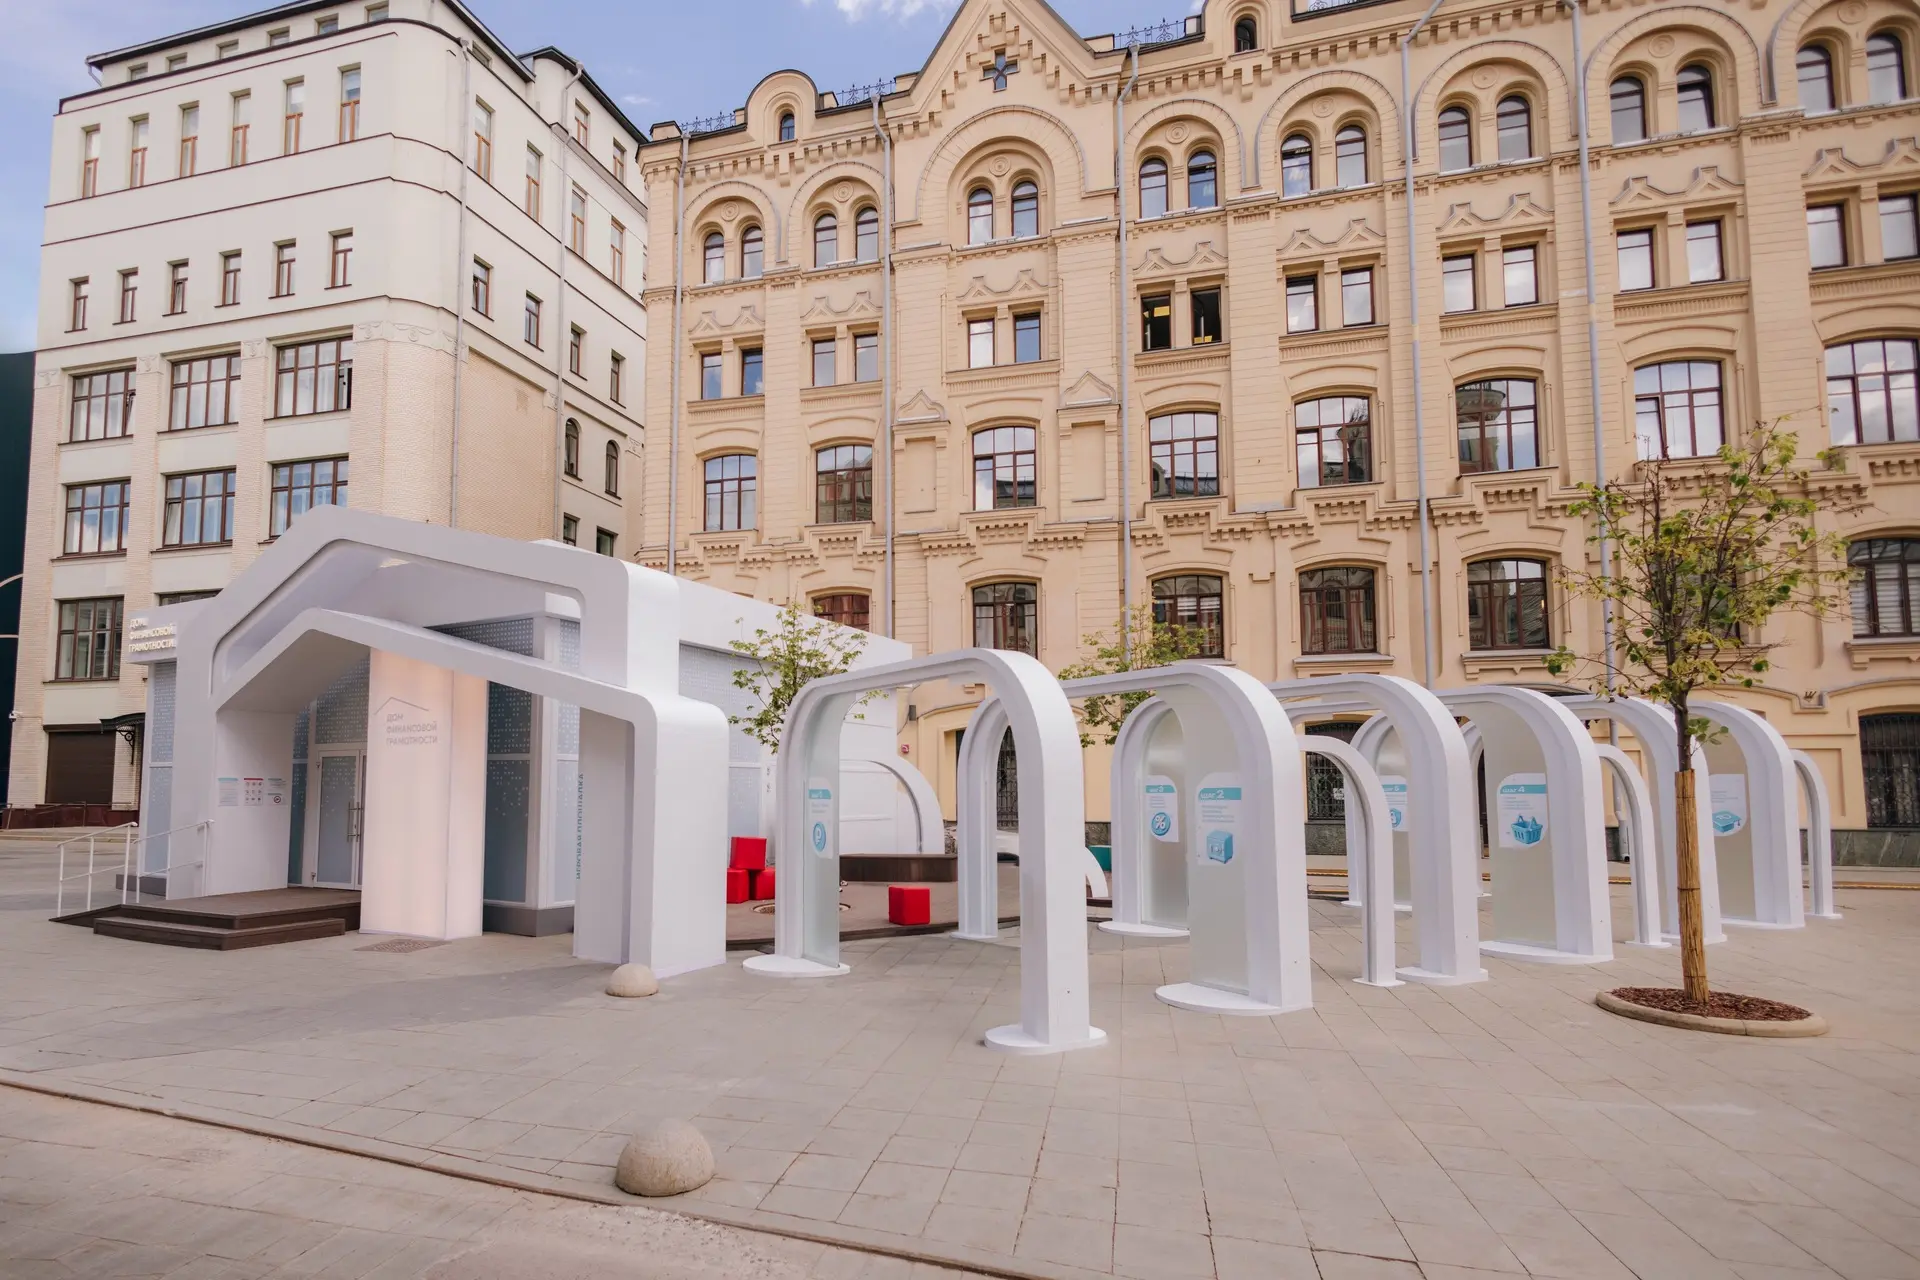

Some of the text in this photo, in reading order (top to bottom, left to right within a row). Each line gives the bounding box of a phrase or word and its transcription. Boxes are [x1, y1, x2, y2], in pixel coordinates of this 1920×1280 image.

[386, 713, 404, 722] ДОМ
[386, 721, 437, 733] ФИНАНСОВОЙ
[1216, 789, 1225, 799] 2
